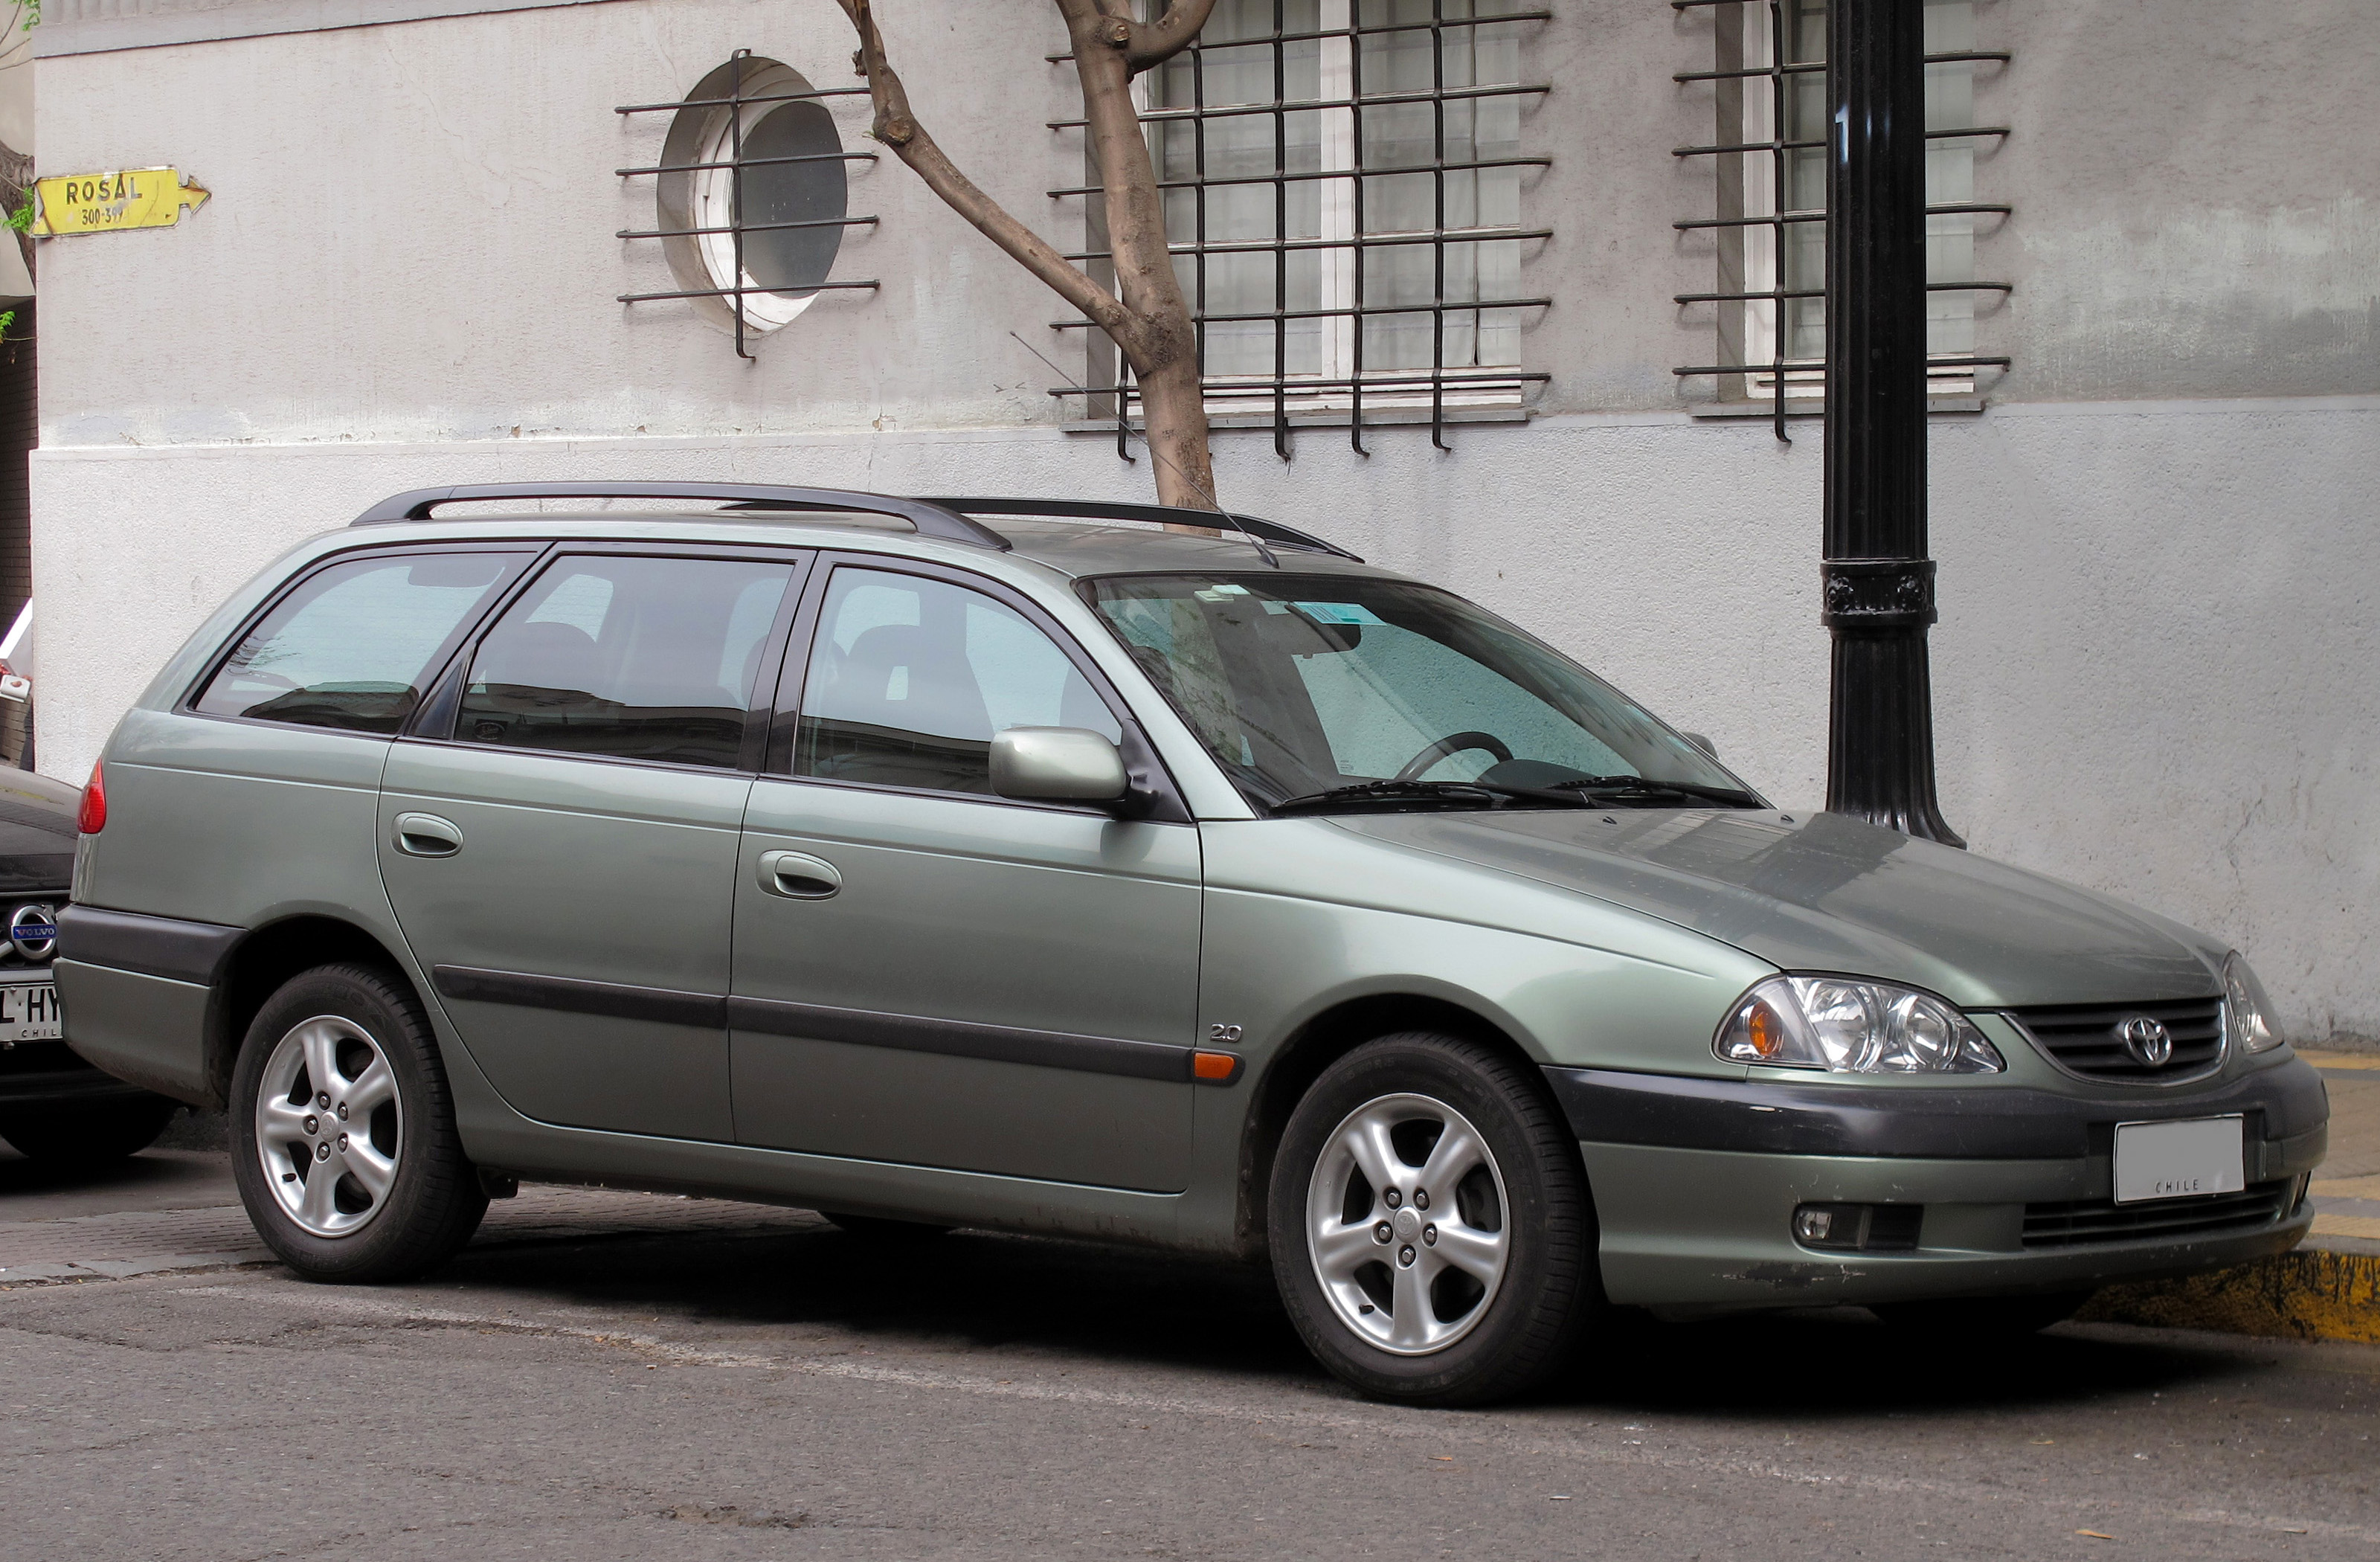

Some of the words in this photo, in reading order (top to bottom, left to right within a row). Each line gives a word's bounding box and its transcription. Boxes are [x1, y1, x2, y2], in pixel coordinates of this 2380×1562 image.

[66, 173, 143, 205] ROSAL
[22, 1029, 57, 1038] CHIL
[2155, 1179, 2199, 1194] CHILE
